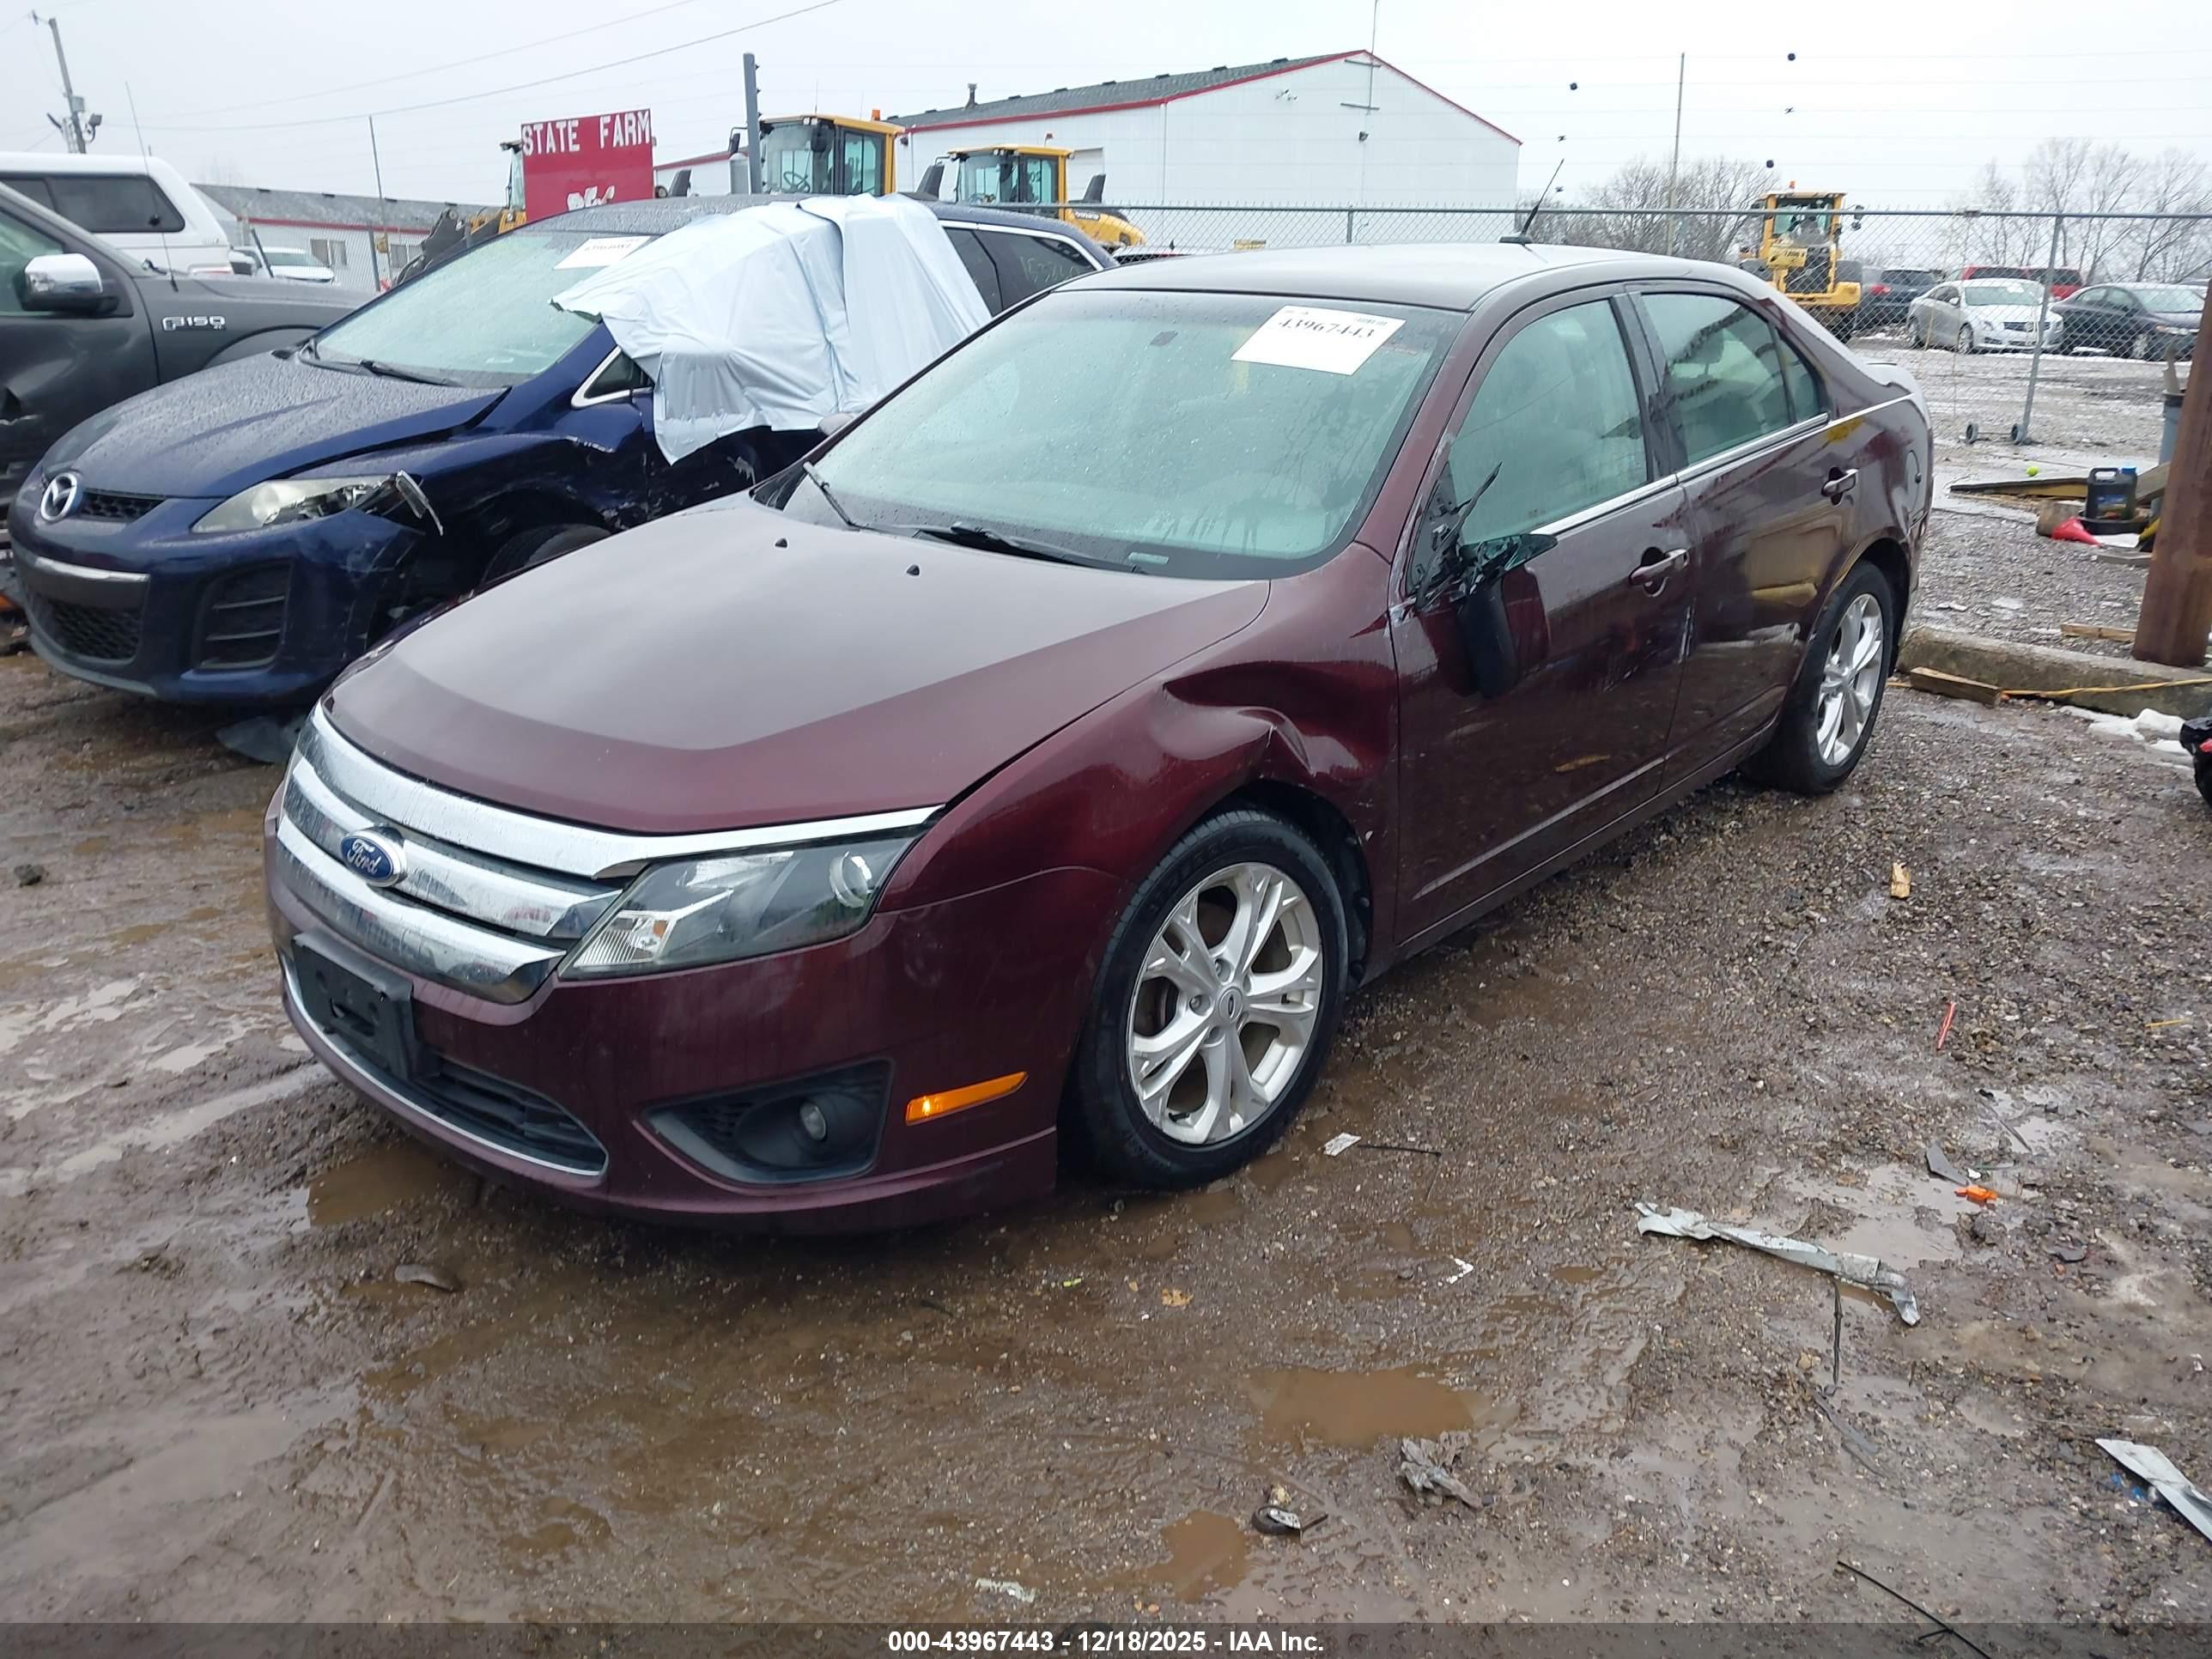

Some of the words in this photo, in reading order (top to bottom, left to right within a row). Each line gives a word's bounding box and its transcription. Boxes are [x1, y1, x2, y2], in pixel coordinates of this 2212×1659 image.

[522, 119, 580, 156] STATE
[599, 110, 650, 149] FARM
[1278, 318, 1375, 337] 43967443
[347, 838, 382, 874] Ford
